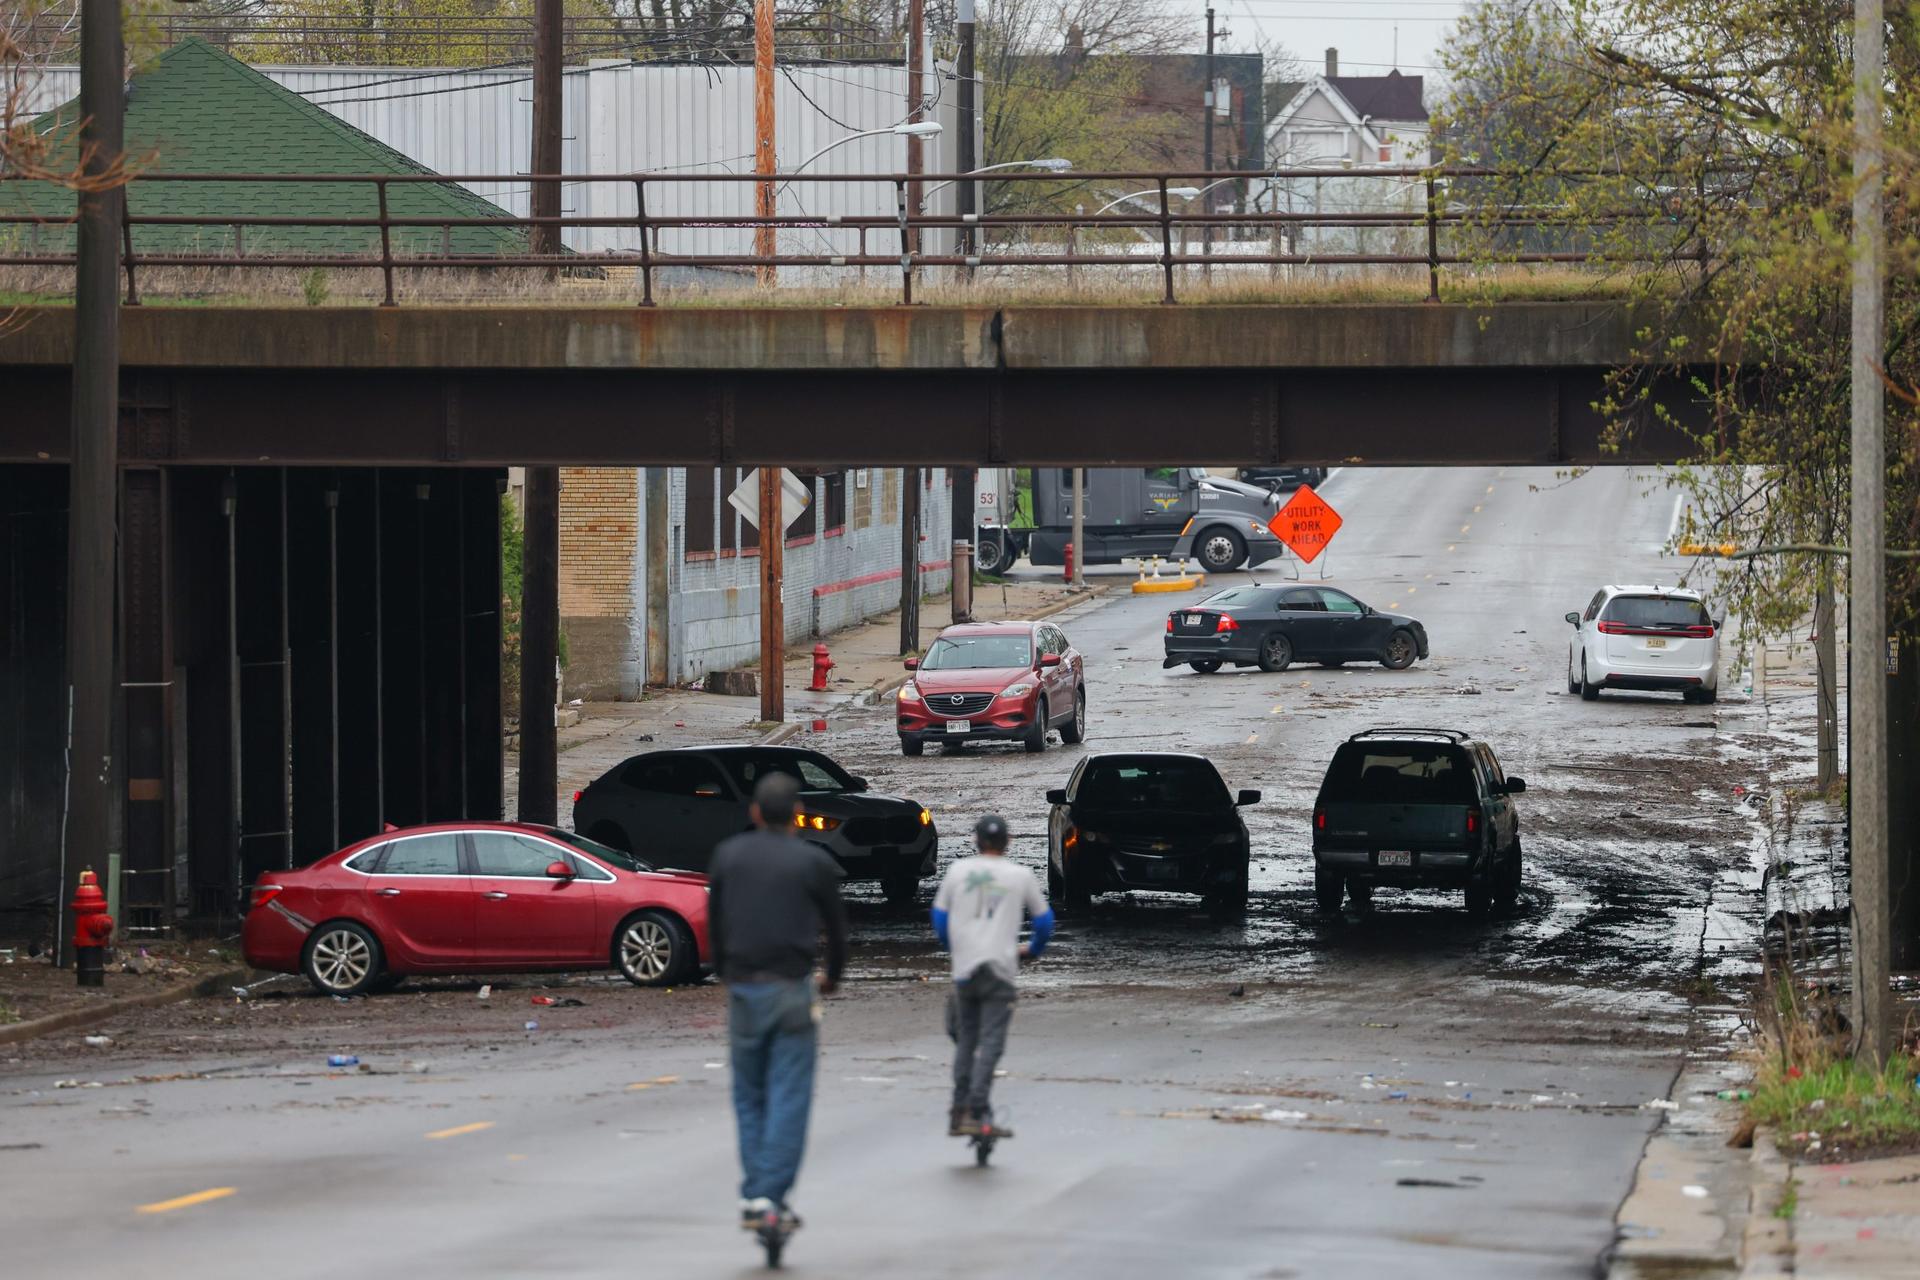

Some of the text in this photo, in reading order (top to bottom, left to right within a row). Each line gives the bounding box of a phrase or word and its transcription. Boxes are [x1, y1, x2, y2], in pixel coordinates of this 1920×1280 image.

[1287, 506, 1324, 518] UTILITY
[1292, 521, 1321, 531] WORK
[1291, 533, 1324, 545] AHEAD
